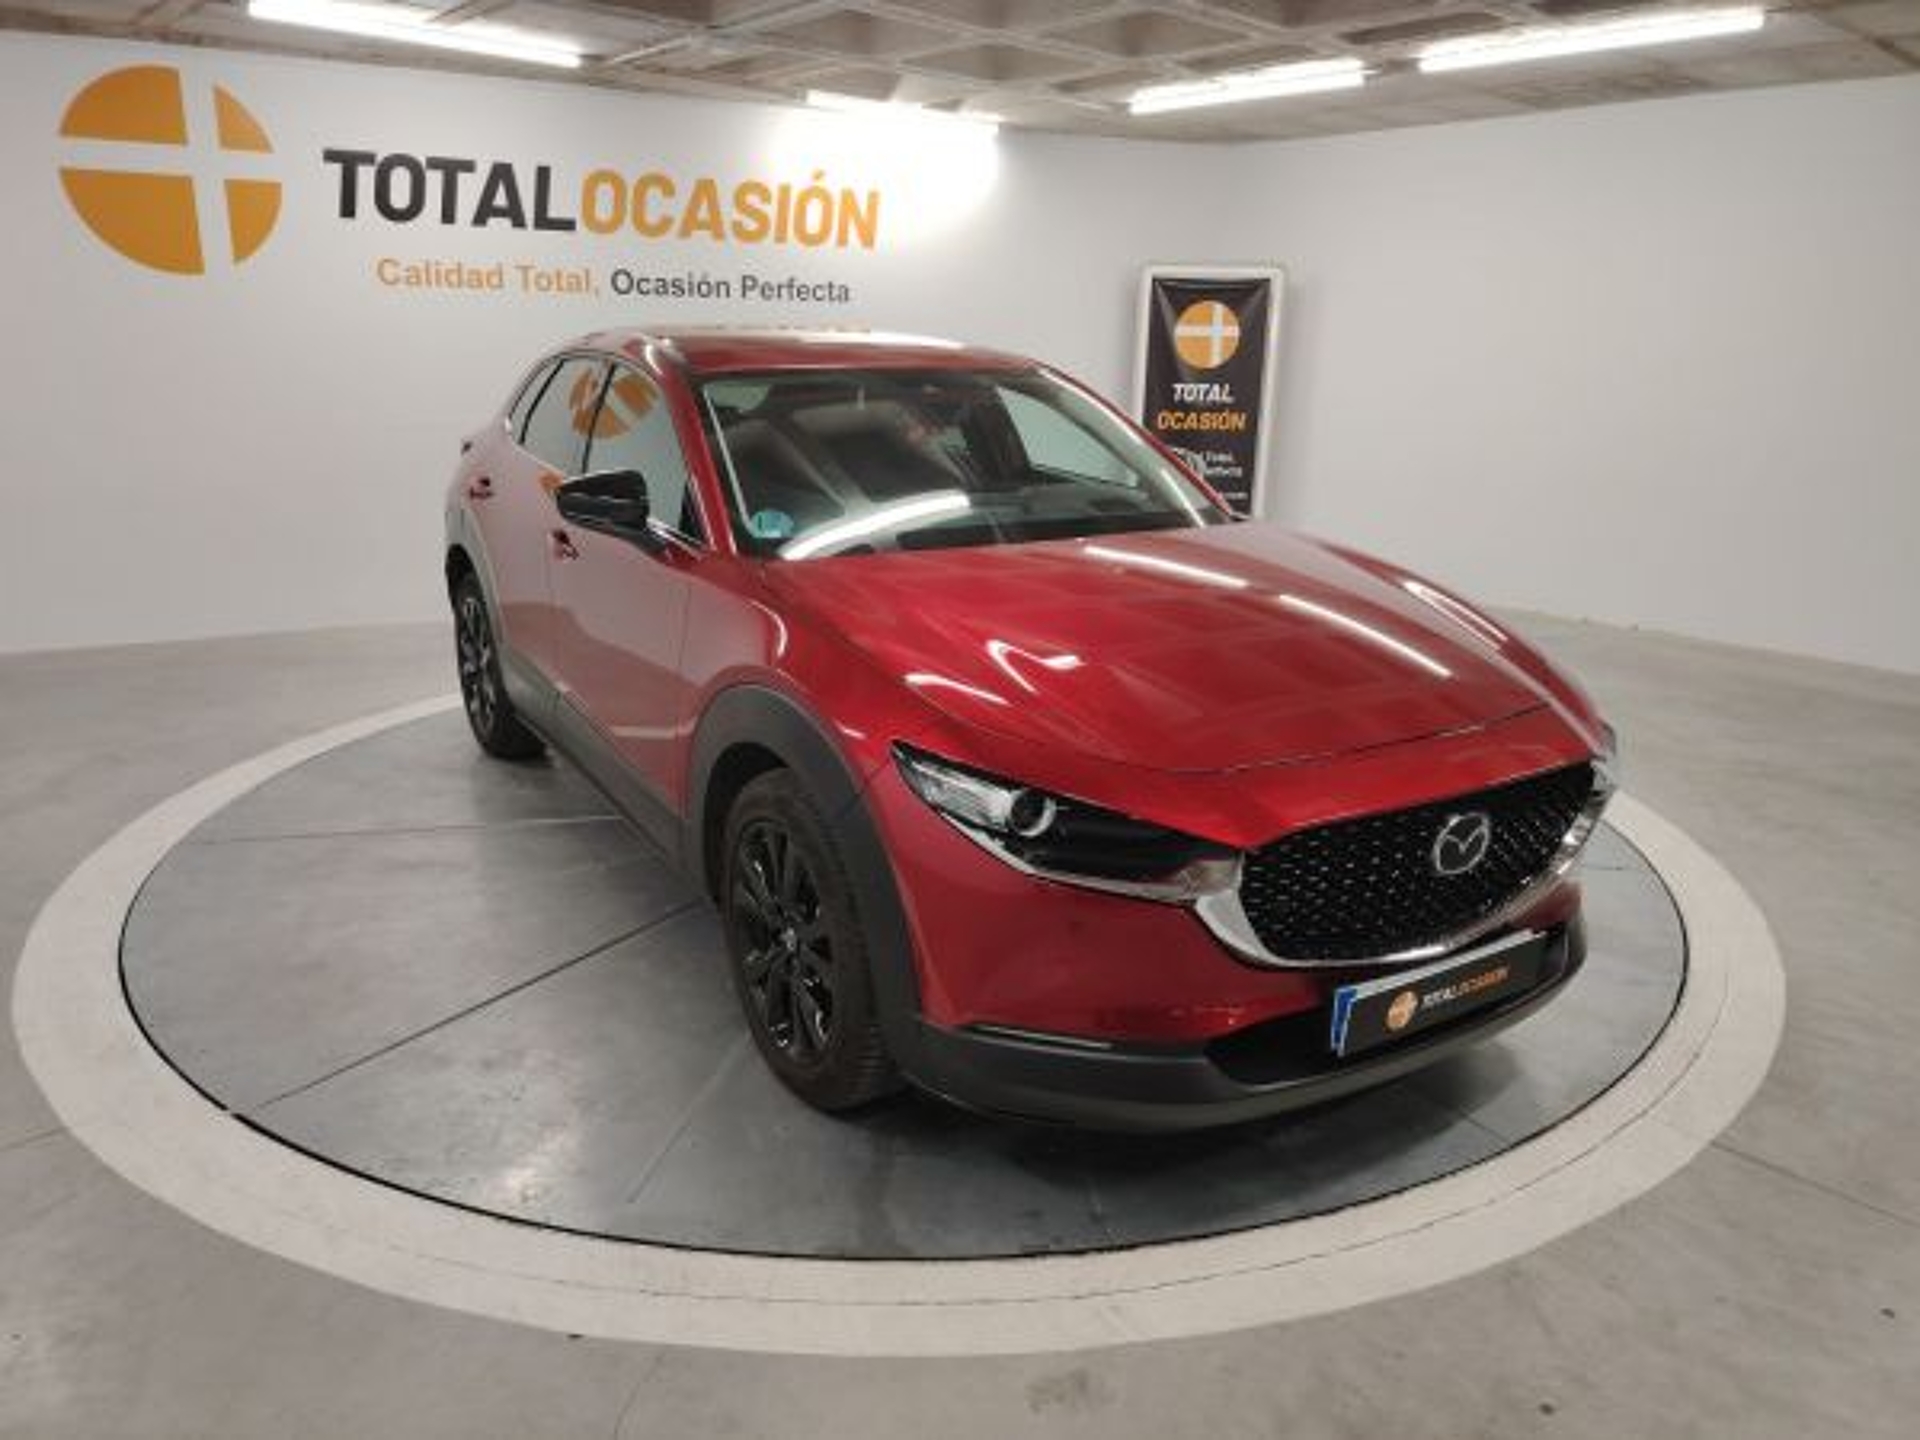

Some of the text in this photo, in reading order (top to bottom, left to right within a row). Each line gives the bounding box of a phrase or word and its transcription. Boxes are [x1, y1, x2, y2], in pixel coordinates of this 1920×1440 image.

[376, 258, 850, 303] Calidad Total, Ocasión Perfecta
[1172, 383, 1235, 403] TOTAL
[1158, 408, 1246, 432] OCASIÓN
